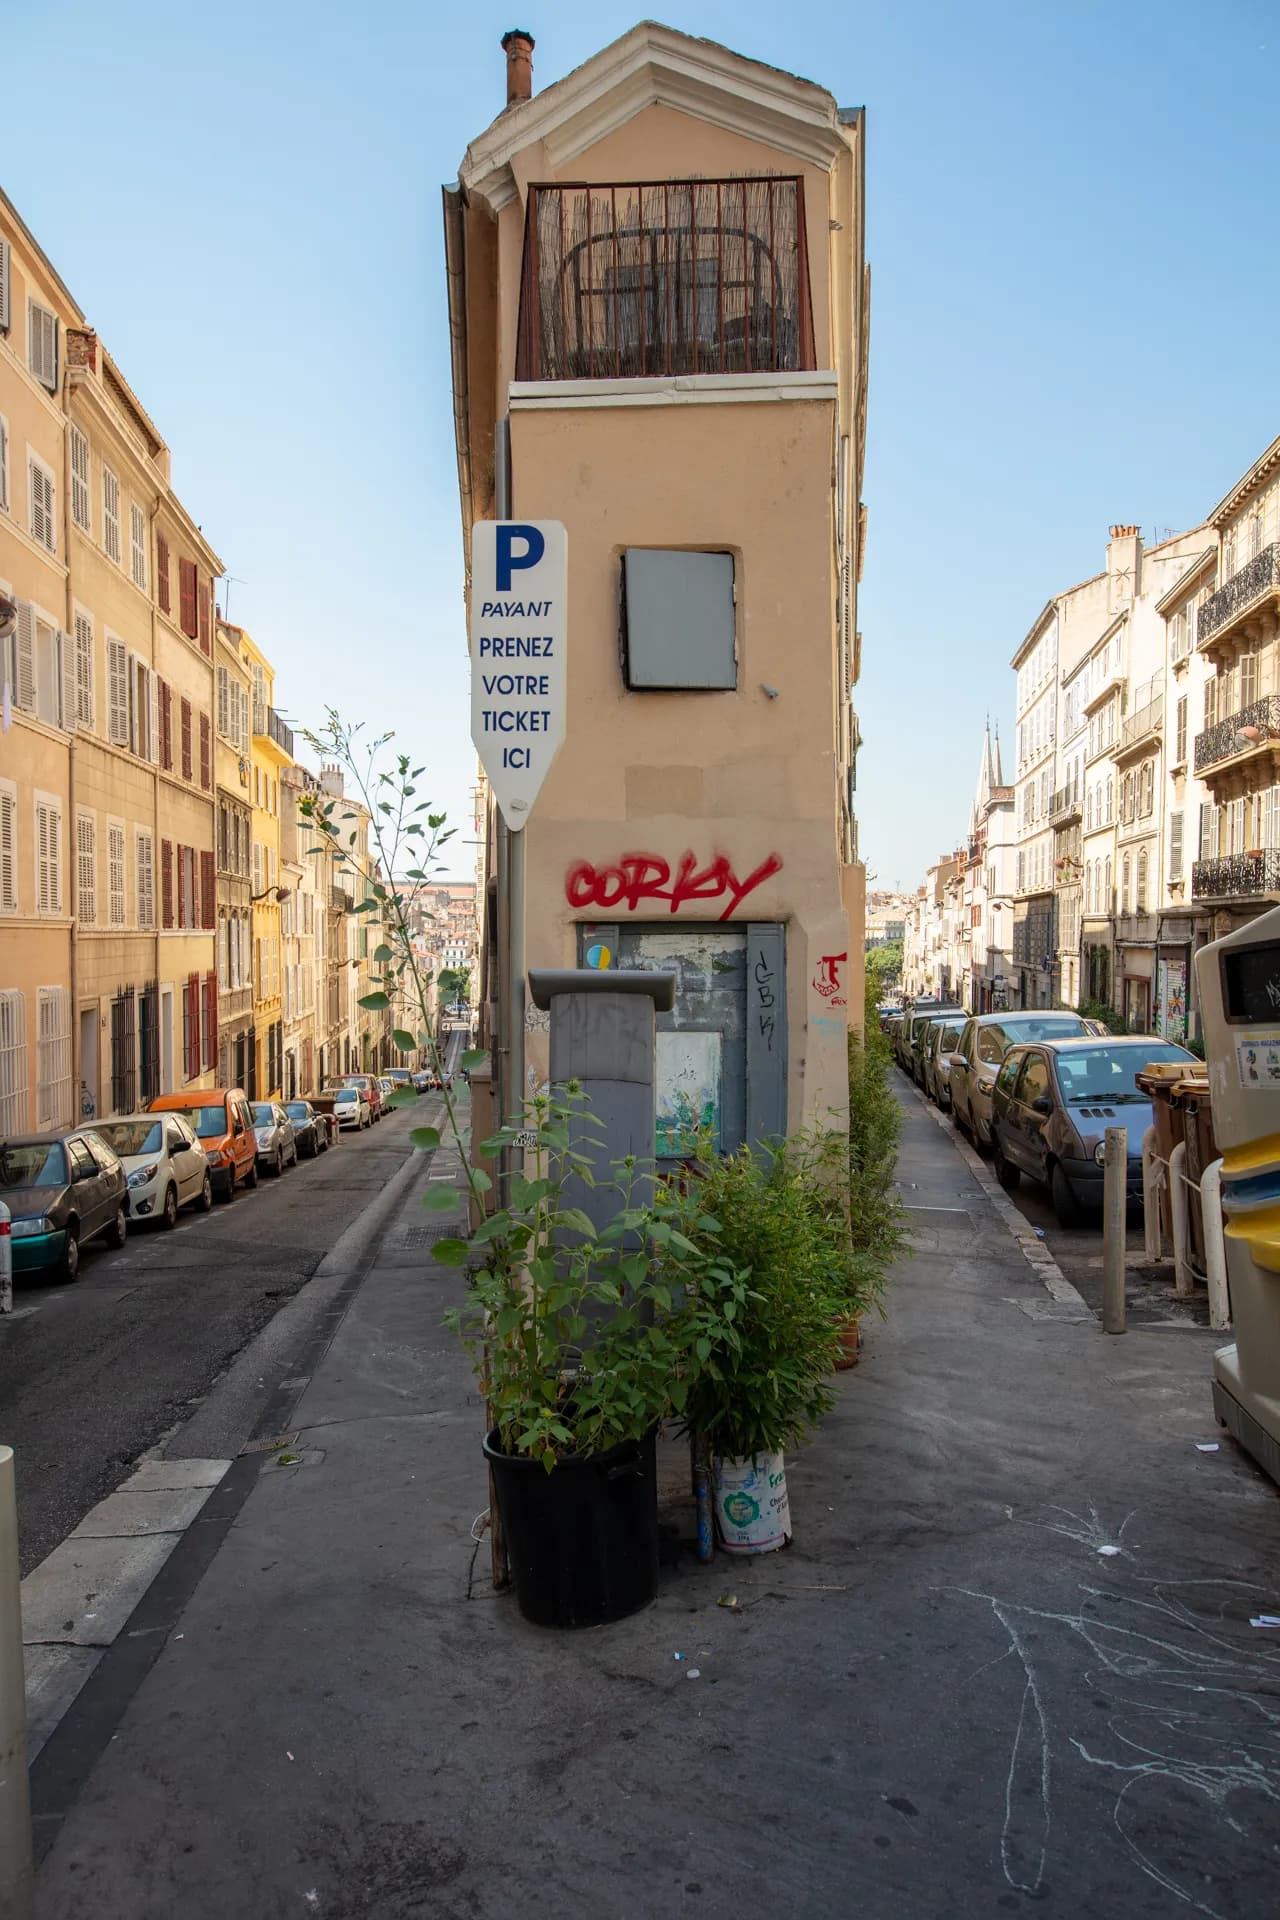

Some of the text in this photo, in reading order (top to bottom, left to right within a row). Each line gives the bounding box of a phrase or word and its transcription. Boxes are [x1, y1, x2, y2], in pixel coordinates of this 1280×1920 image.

[495, 524, 545, 591] P
[480, 601, 553, 618] PAYANT
[479, 637, 554, 658] PRENEZ
[481, 674, 550, 696] VOTRE
[481, 710, 551, 733] TICKET
[502, 747, 531, 769] ICI
